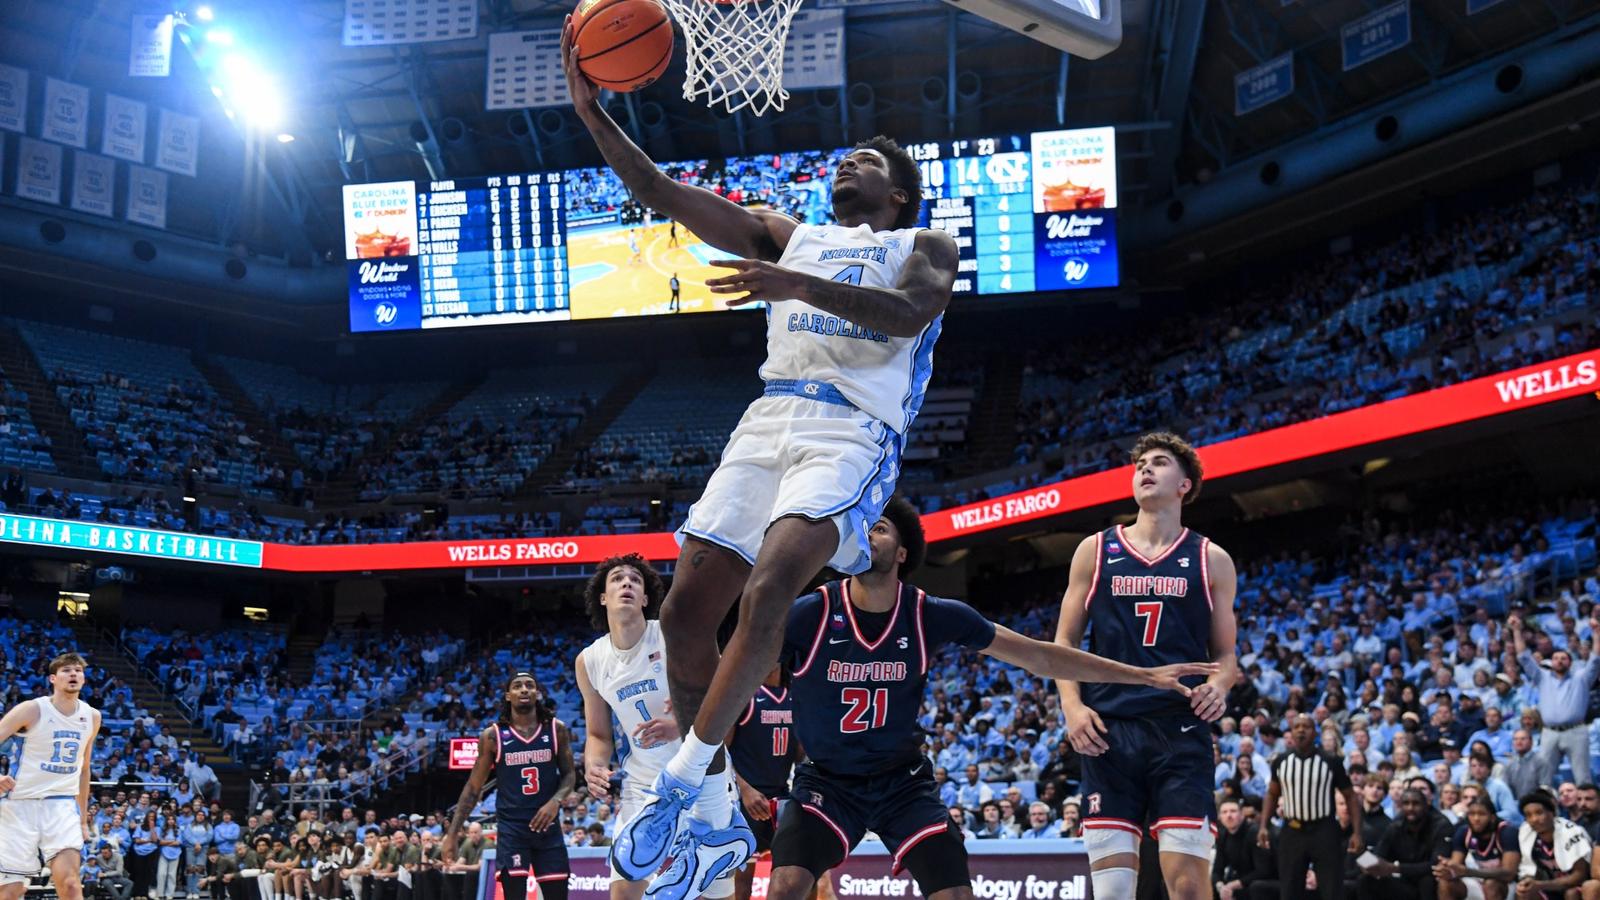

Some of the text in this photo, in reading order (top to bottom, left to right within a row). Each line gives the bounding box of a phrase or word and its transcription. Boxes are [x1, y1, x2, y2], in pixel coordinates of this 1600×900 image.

[978, 138, 994, 155] 23
[1042, 136, 1102, 148] CAROLINA
[1040, 147, 1104, 158] BLUE BREW
[920, 160, 944, 188] 10
[956, 158, 980, 184] 14
[430, 180, 455, 191] PLAYER
[488, 177, 501, 187] PTS
[528, 174, 540, 184] AST
[354, 188, 406, 199] CAROLINA
[419, 194, 426, 205] 3
[352, 200, 376, 208] BLUE
[420, 206, 426, 218] 7
[998, 196, 1008, 212] 4
[420, 242, 432, 254] 24
[432, 241, 458, 254] WALLS
[999, 234, 1010, 252] 3
[818, 246, 888, 264] NORTH
[1000, 254, 1012, 272] 3
[424, 266, 428, 278] 1
[1064, 260, 1089, 280] W
[1000, 274, 1012, 290] 4
[424, 291, 432, 303] 4
[376, 305, 397, 322] W
[1494, 359, 1597, 402] WELLS
[950, 490, 1060, 530] WELLS FARGO
[90, 528, 238, 561] BASKETBALL
[448, 542, 579, 562] WELLS FARGO
[1111, 576, 1188, 598] RADFORD
[1134, 601, 1164, 647] 7
[828, 660, 908, 682] RADFORD
[616, 678, 659, 702] NORTH
[634, 700, 652, 722] 1
[840, 688, 888, 733] 21
[772, 727, 788, 756] 11
[50, 740, 80, 764] 13
[505, 749, 552, 766] RADFORD
[520, 766, 540, 795] 3
[1087, 792, 1102, 814] R
[839, 874, 909, 896] Smarter
[1026, 874, 1058, 899] for
[1060, 875, 1086, 899] all
